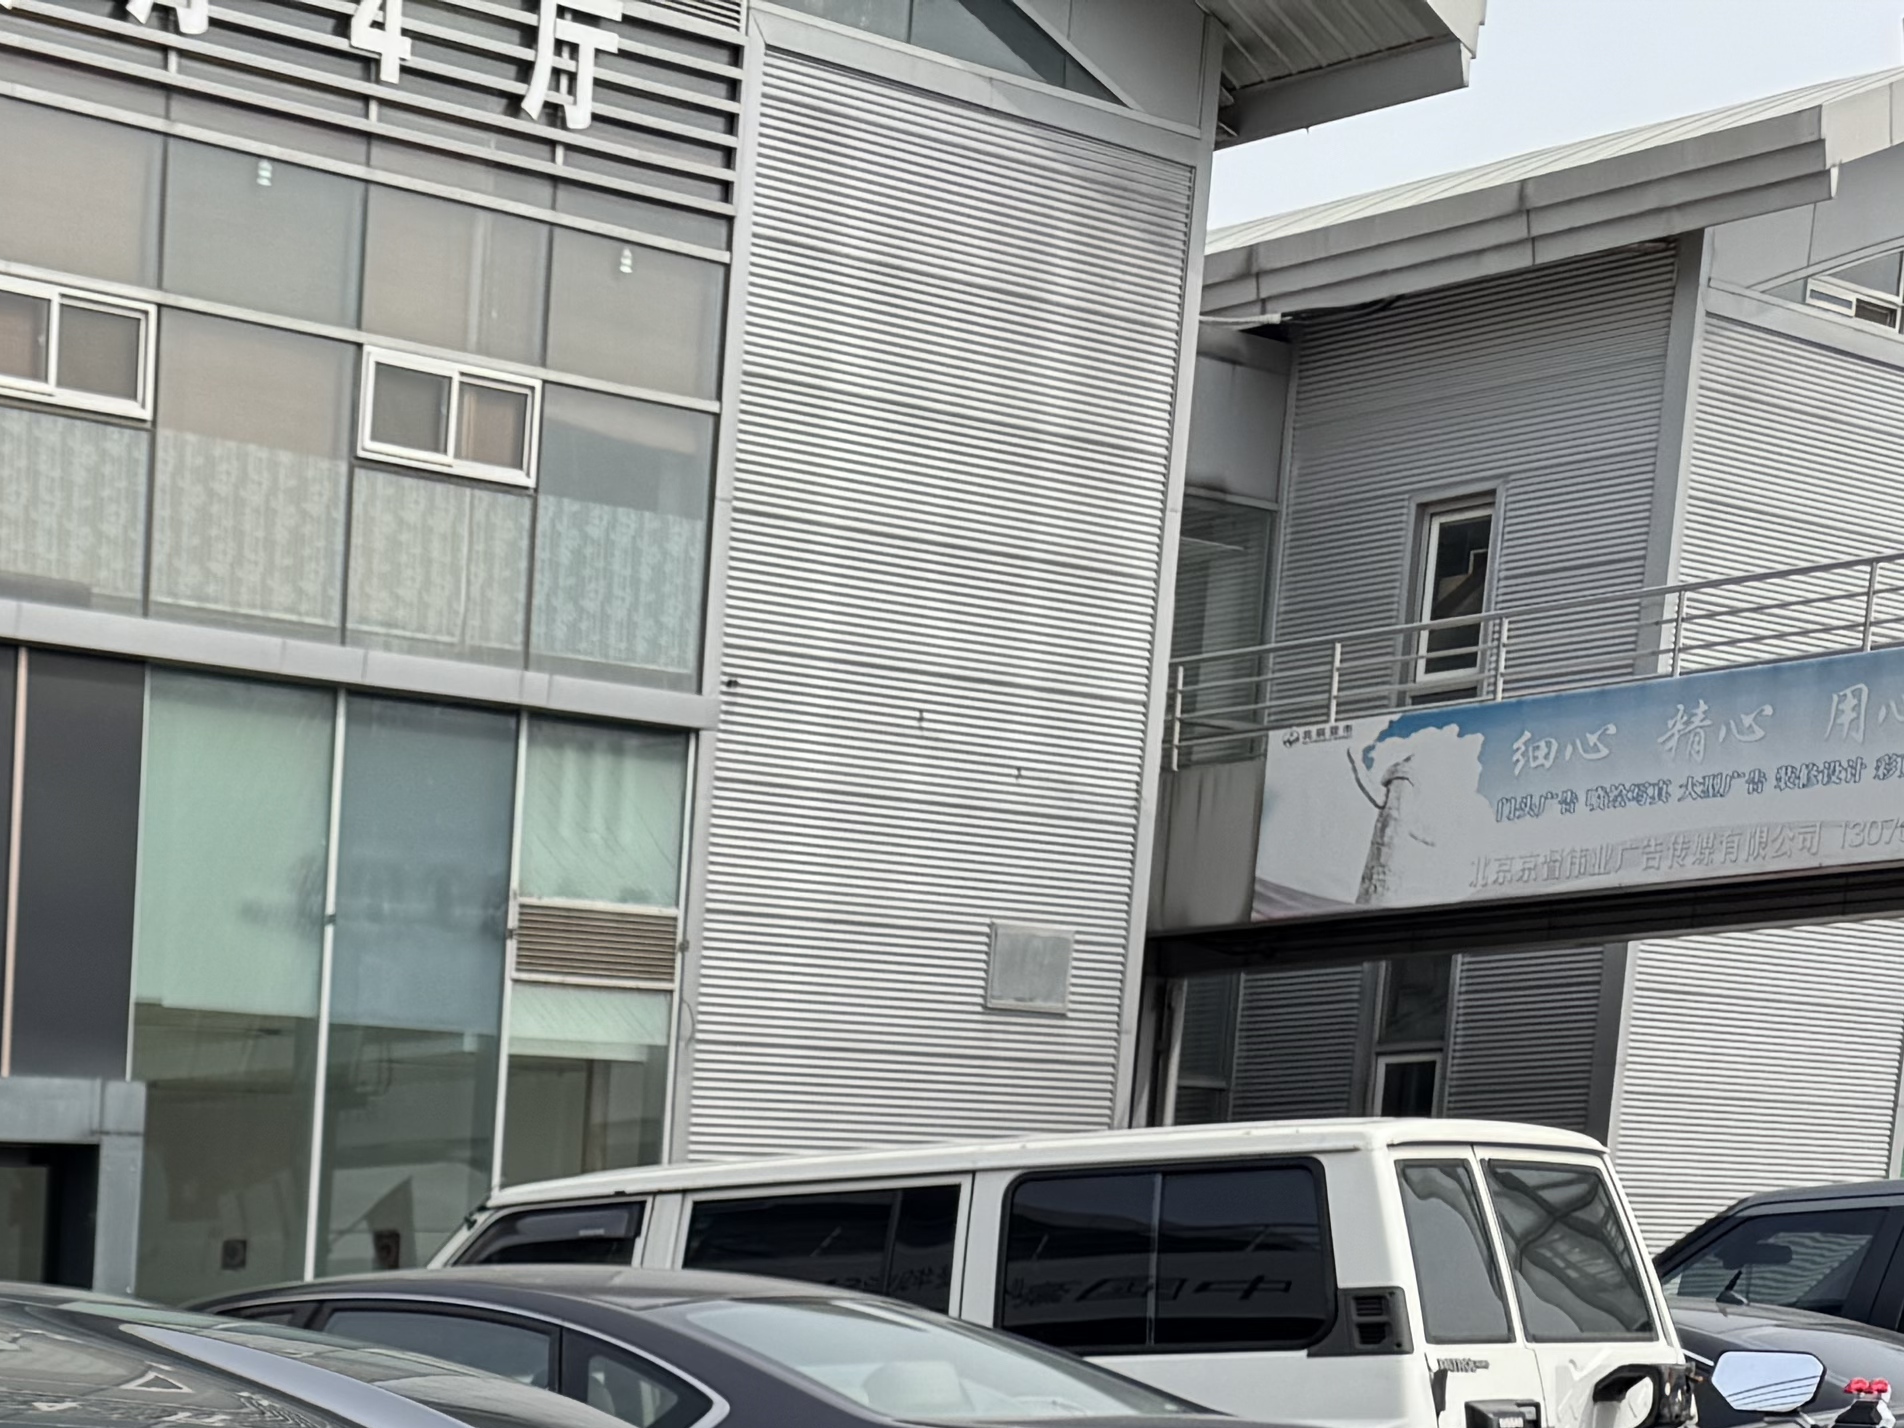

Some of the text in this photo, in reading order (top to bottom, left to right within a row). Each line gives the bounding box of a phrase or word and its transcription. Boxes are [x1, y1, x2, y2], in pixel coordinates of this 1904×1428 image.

[1512, 723, 1617, 777] 细心
[1657, 698, 1774, 764] 精心
[1677, 767, 1768, 802] 大型广告
